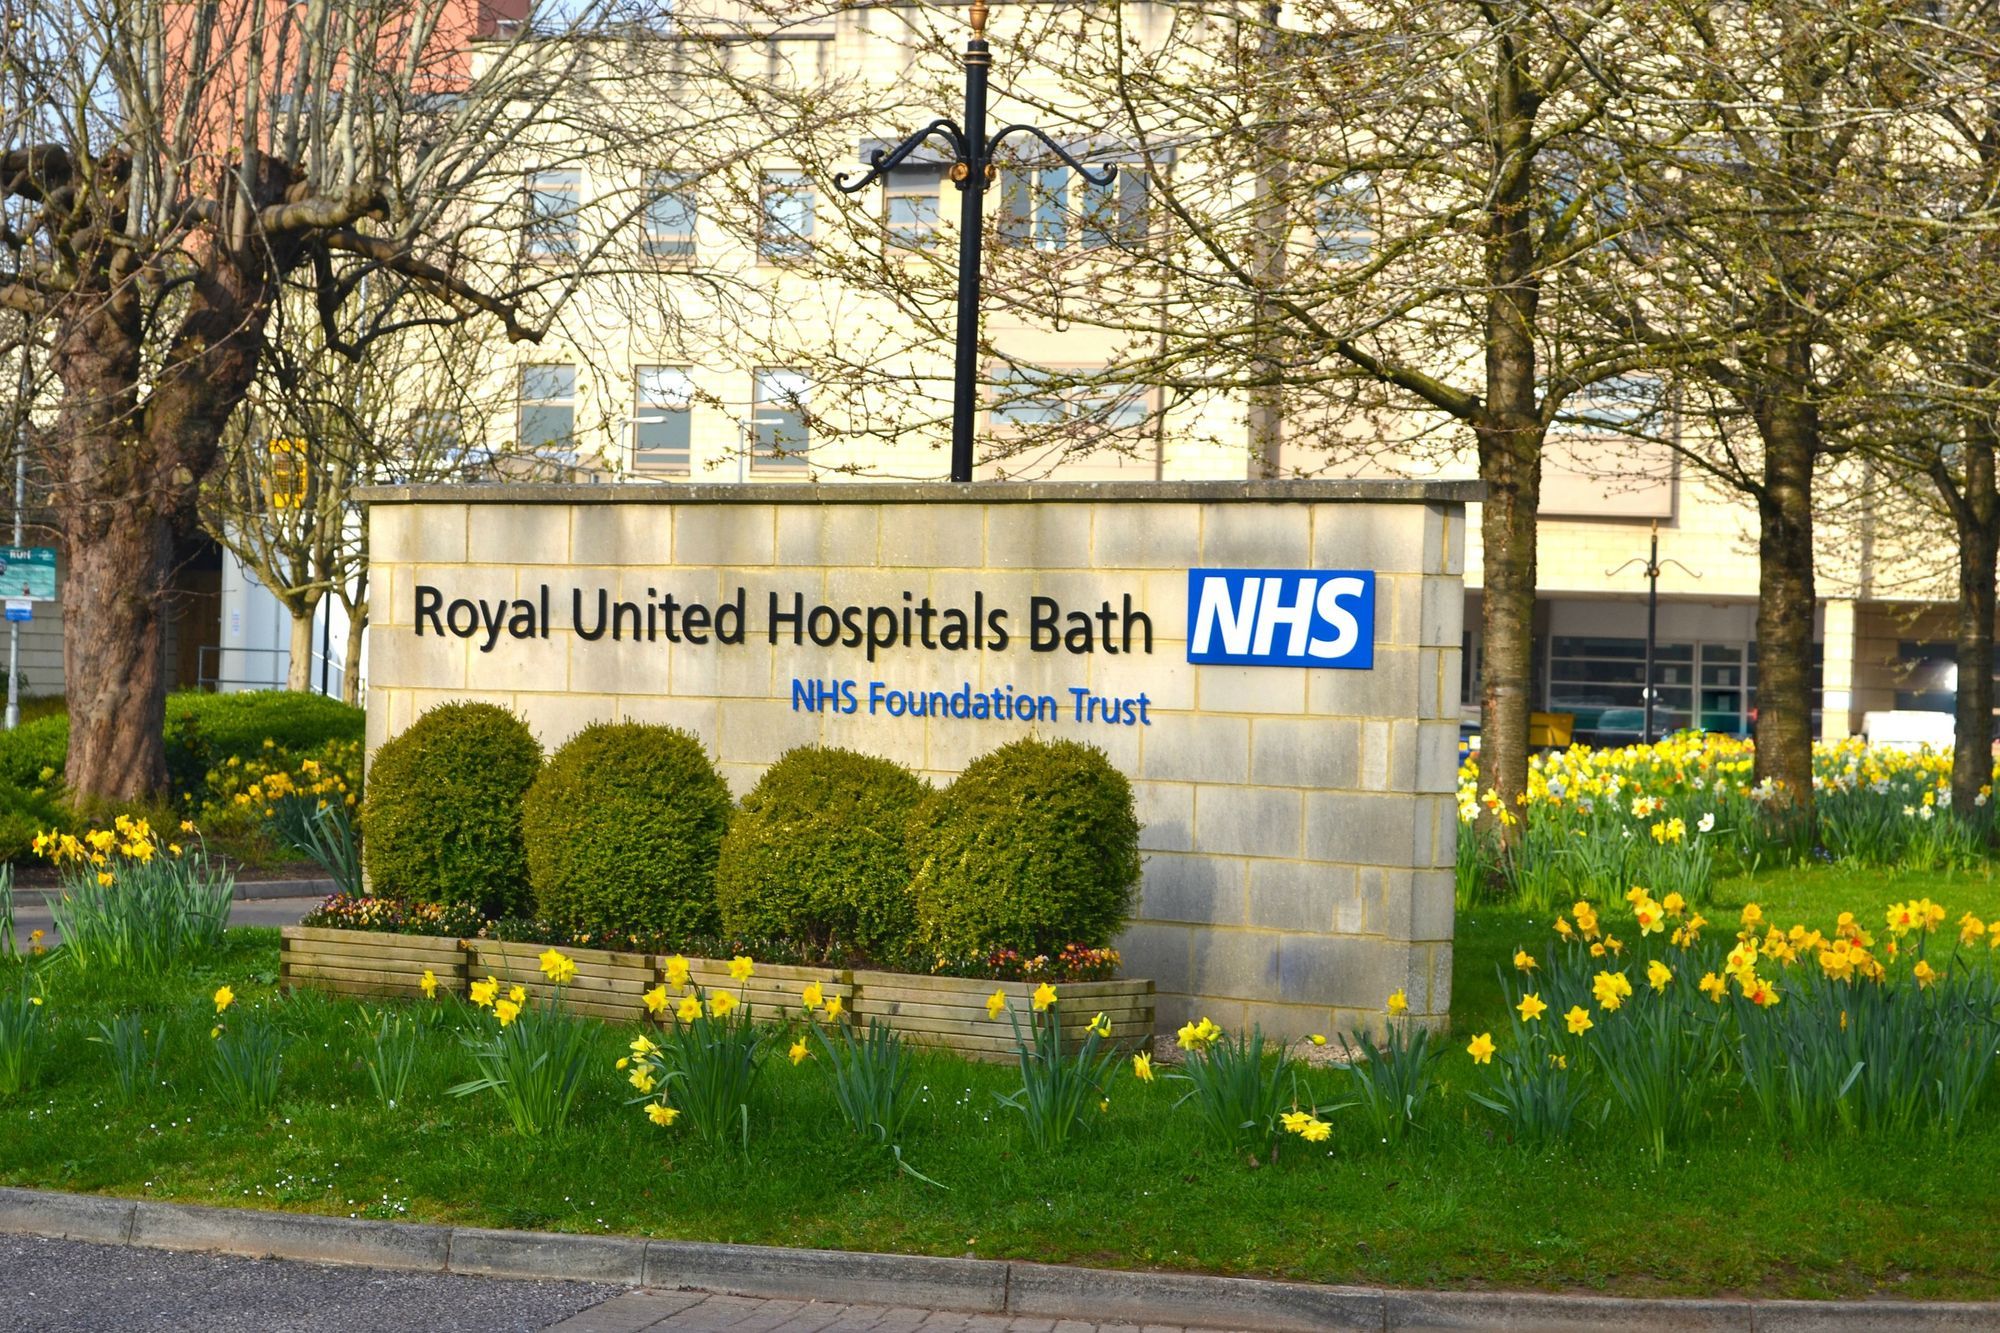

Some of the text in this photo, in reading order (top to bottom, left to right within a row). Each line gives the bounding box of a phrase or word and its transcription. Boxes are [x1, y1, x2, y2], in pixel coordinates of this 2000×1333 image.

[415, 584, 1154, 663] Royal United Hospitals Bath
[1191, 576, 1365, 659] NHS
[791, 677, 1151, 725] NHS Foundation Trust
